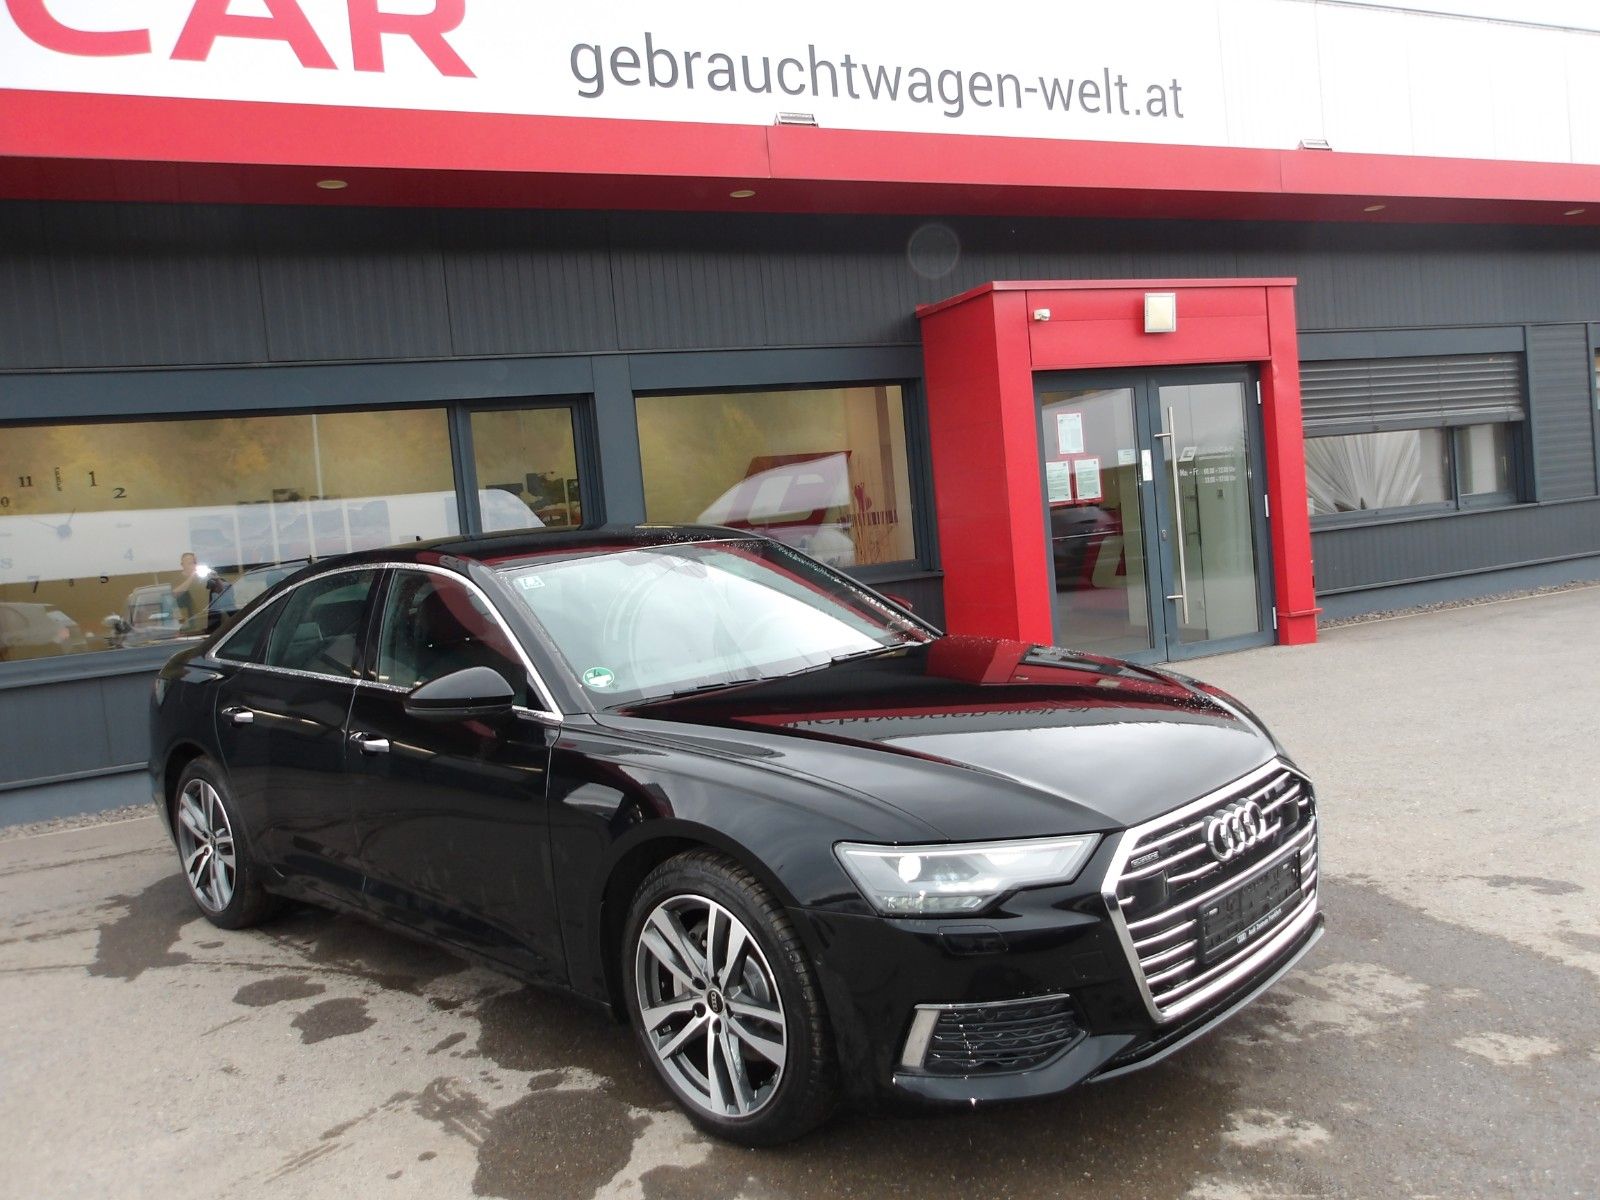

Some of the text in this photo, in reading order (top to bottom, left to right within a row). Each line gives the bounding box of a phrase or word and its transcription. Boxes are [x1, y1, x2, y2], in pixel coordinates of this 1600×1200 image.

[569, 31, 1185, 119] gebrauchtwagen-welt.at
[18, 476, 33, 487] 11
[112, 487, 127, 499] 2
